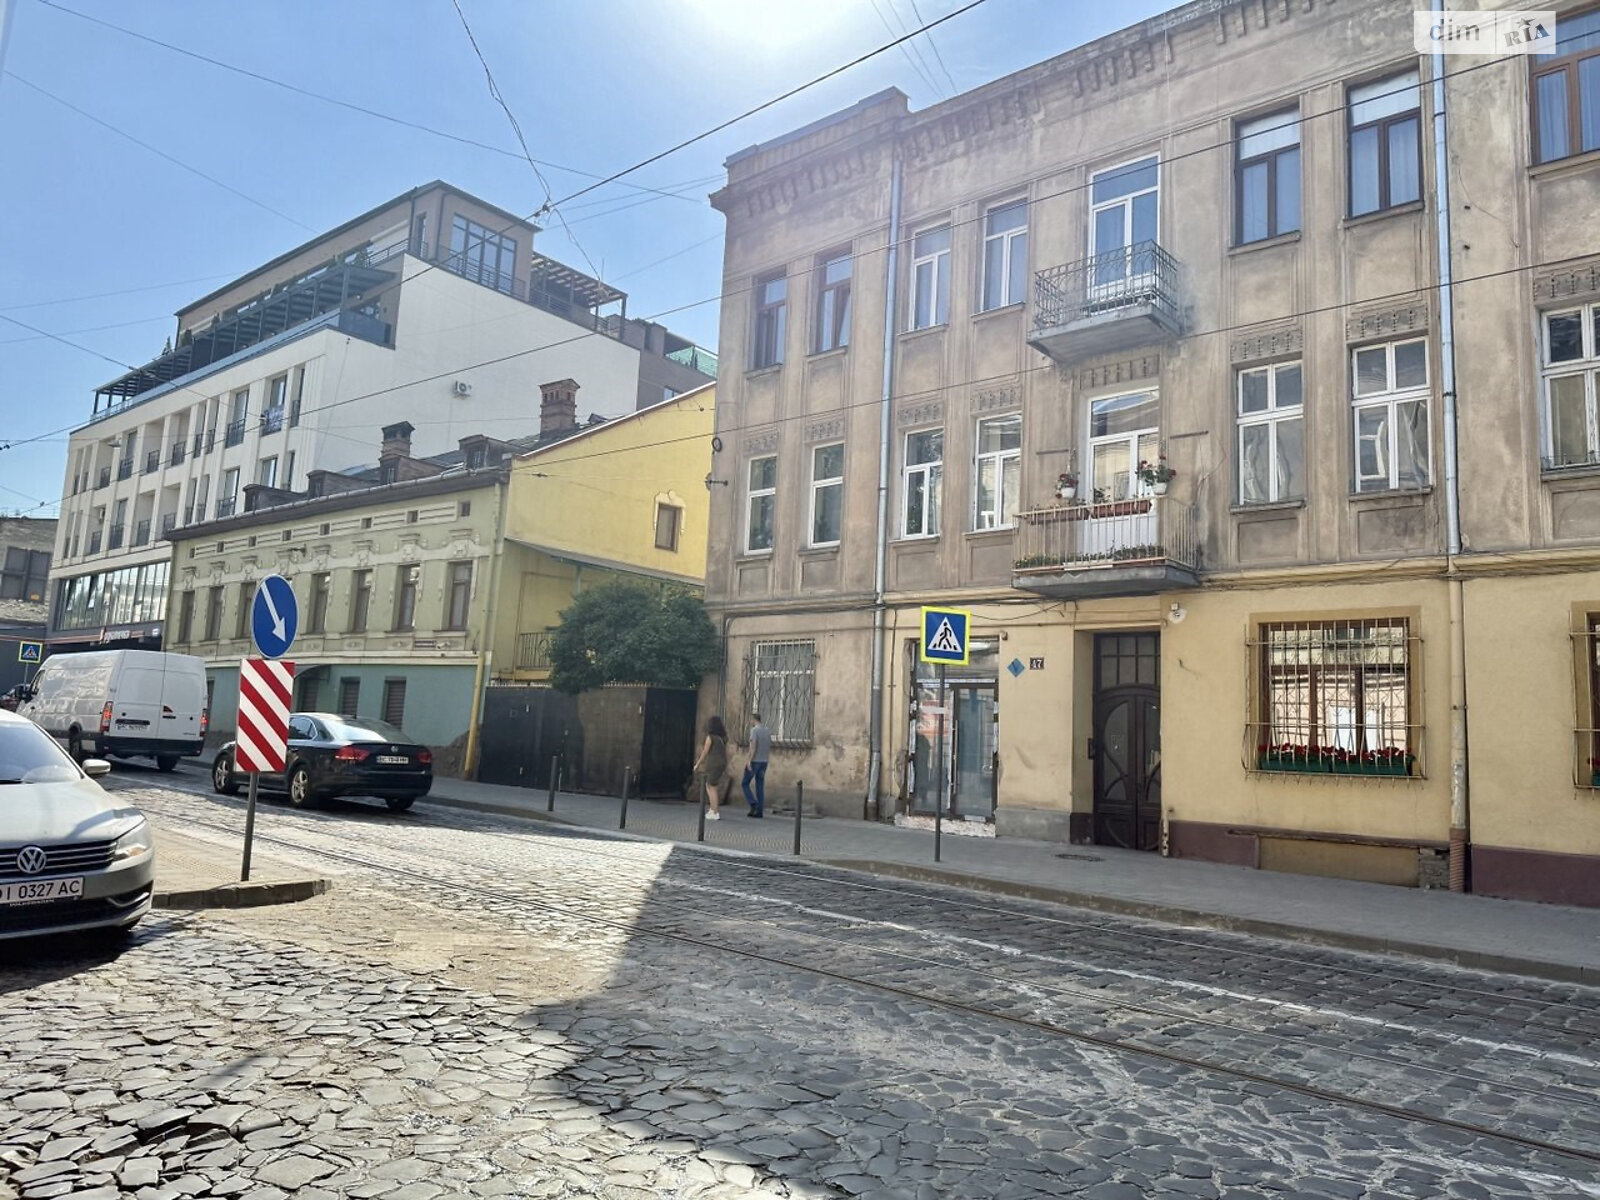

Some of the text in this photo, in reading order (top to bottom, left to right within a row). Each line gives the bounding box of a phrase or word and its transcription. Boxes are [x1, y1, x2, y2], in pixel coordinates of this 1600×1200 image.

[1031, 659, 1042, 669] 47
[19, 847, 46, 873] VW
[19, 883, 54, 899] 0327
[58, 880, 80, 895] AC
